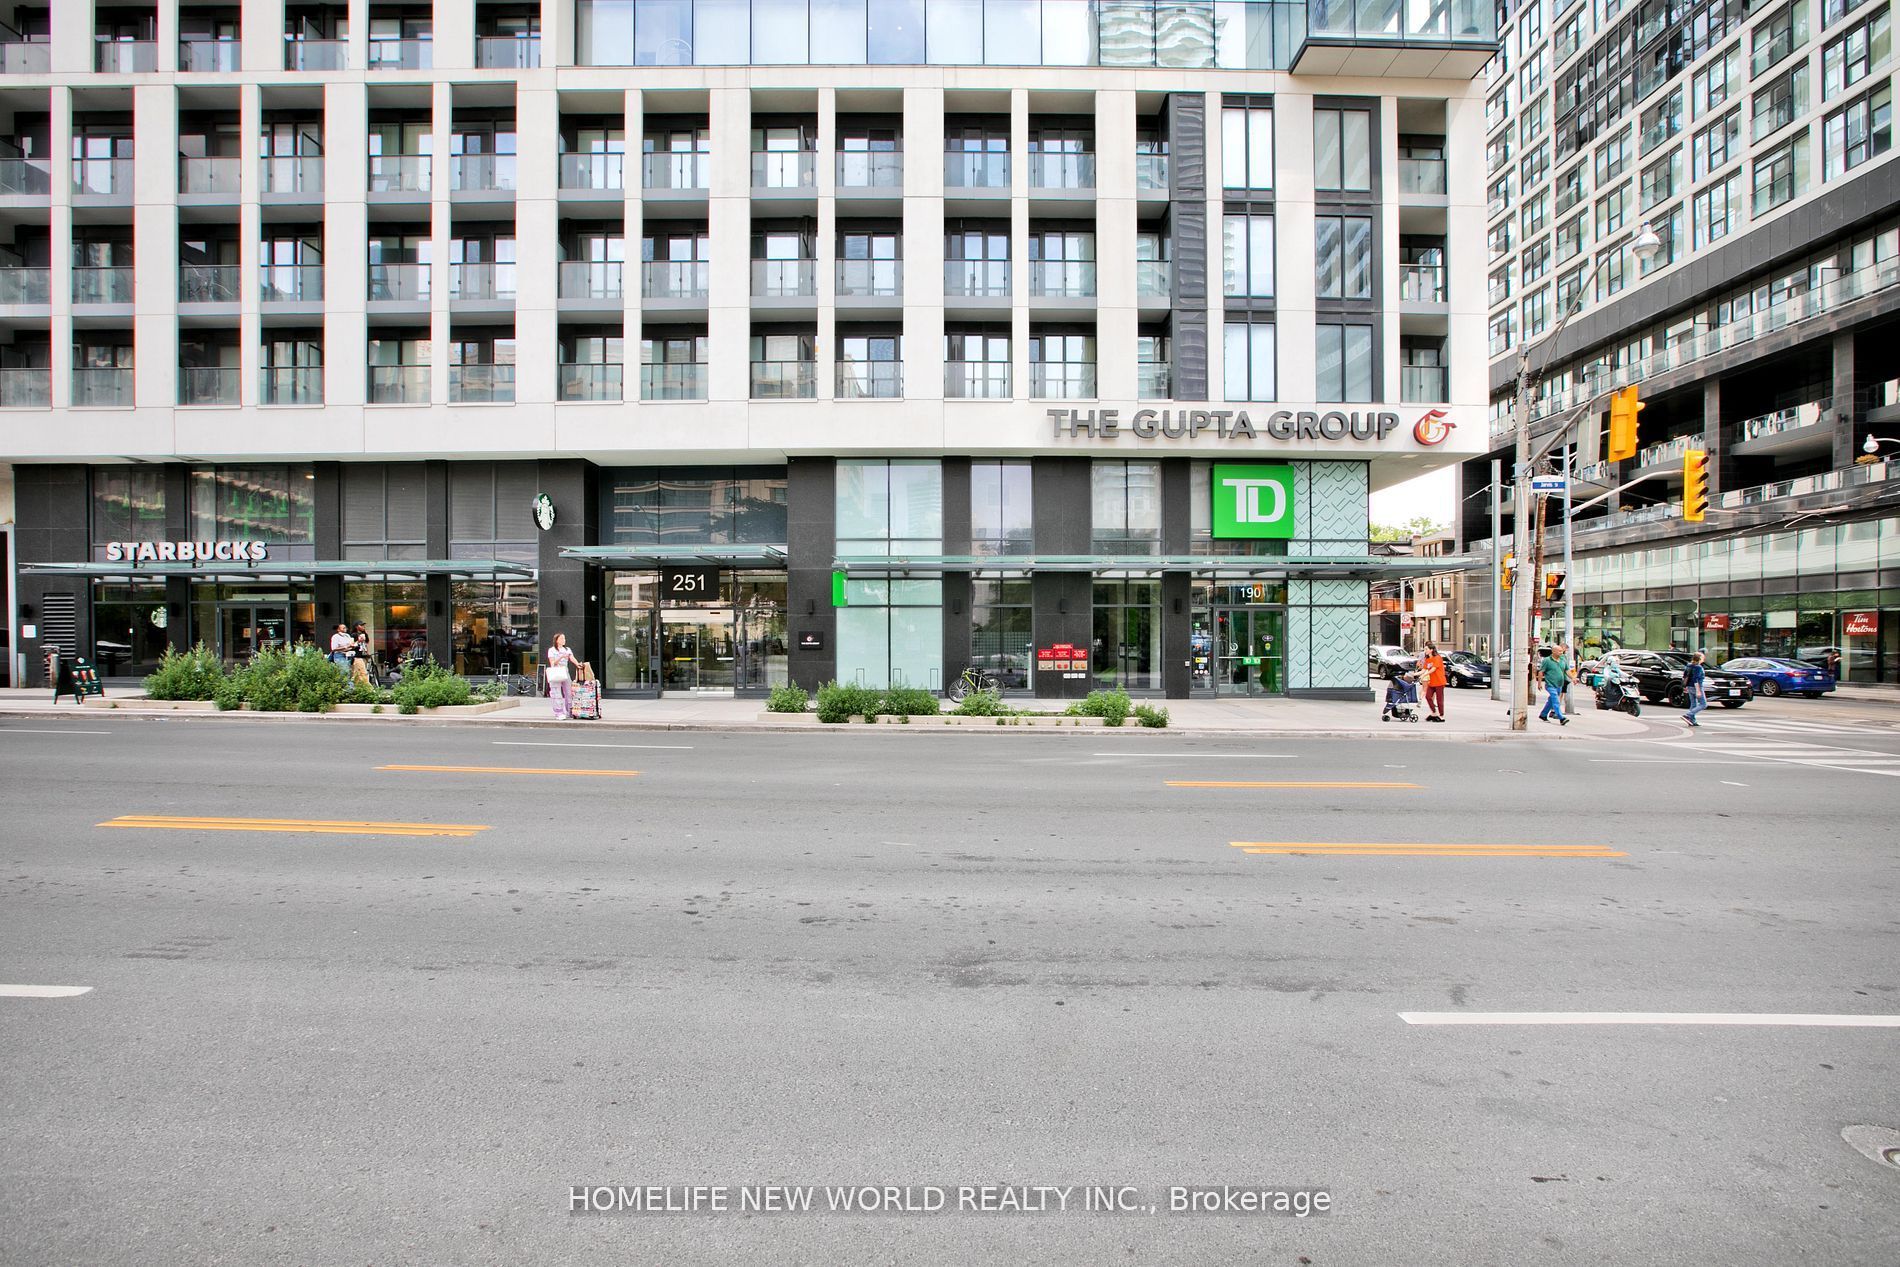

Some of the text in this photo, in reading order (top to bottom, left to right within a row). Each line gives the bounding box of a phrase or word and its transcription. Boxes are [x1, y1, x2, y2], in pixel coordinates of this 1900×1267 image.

[1047, 409, 1119, 438] THE
[1133, 410, 1260, 440] GUPTA
[1267, 410, 1400, 441] GROUP
[1222, 478, 1287, 523] TD
[106, 541, 268, 561] STARBUCKS
[672, 574, 706, 591] 251
[1240, 587, 1261, 598] 190
[1853, 614, 1869, 623] Tim
[1846, 623, 1877, 633] Hortons
